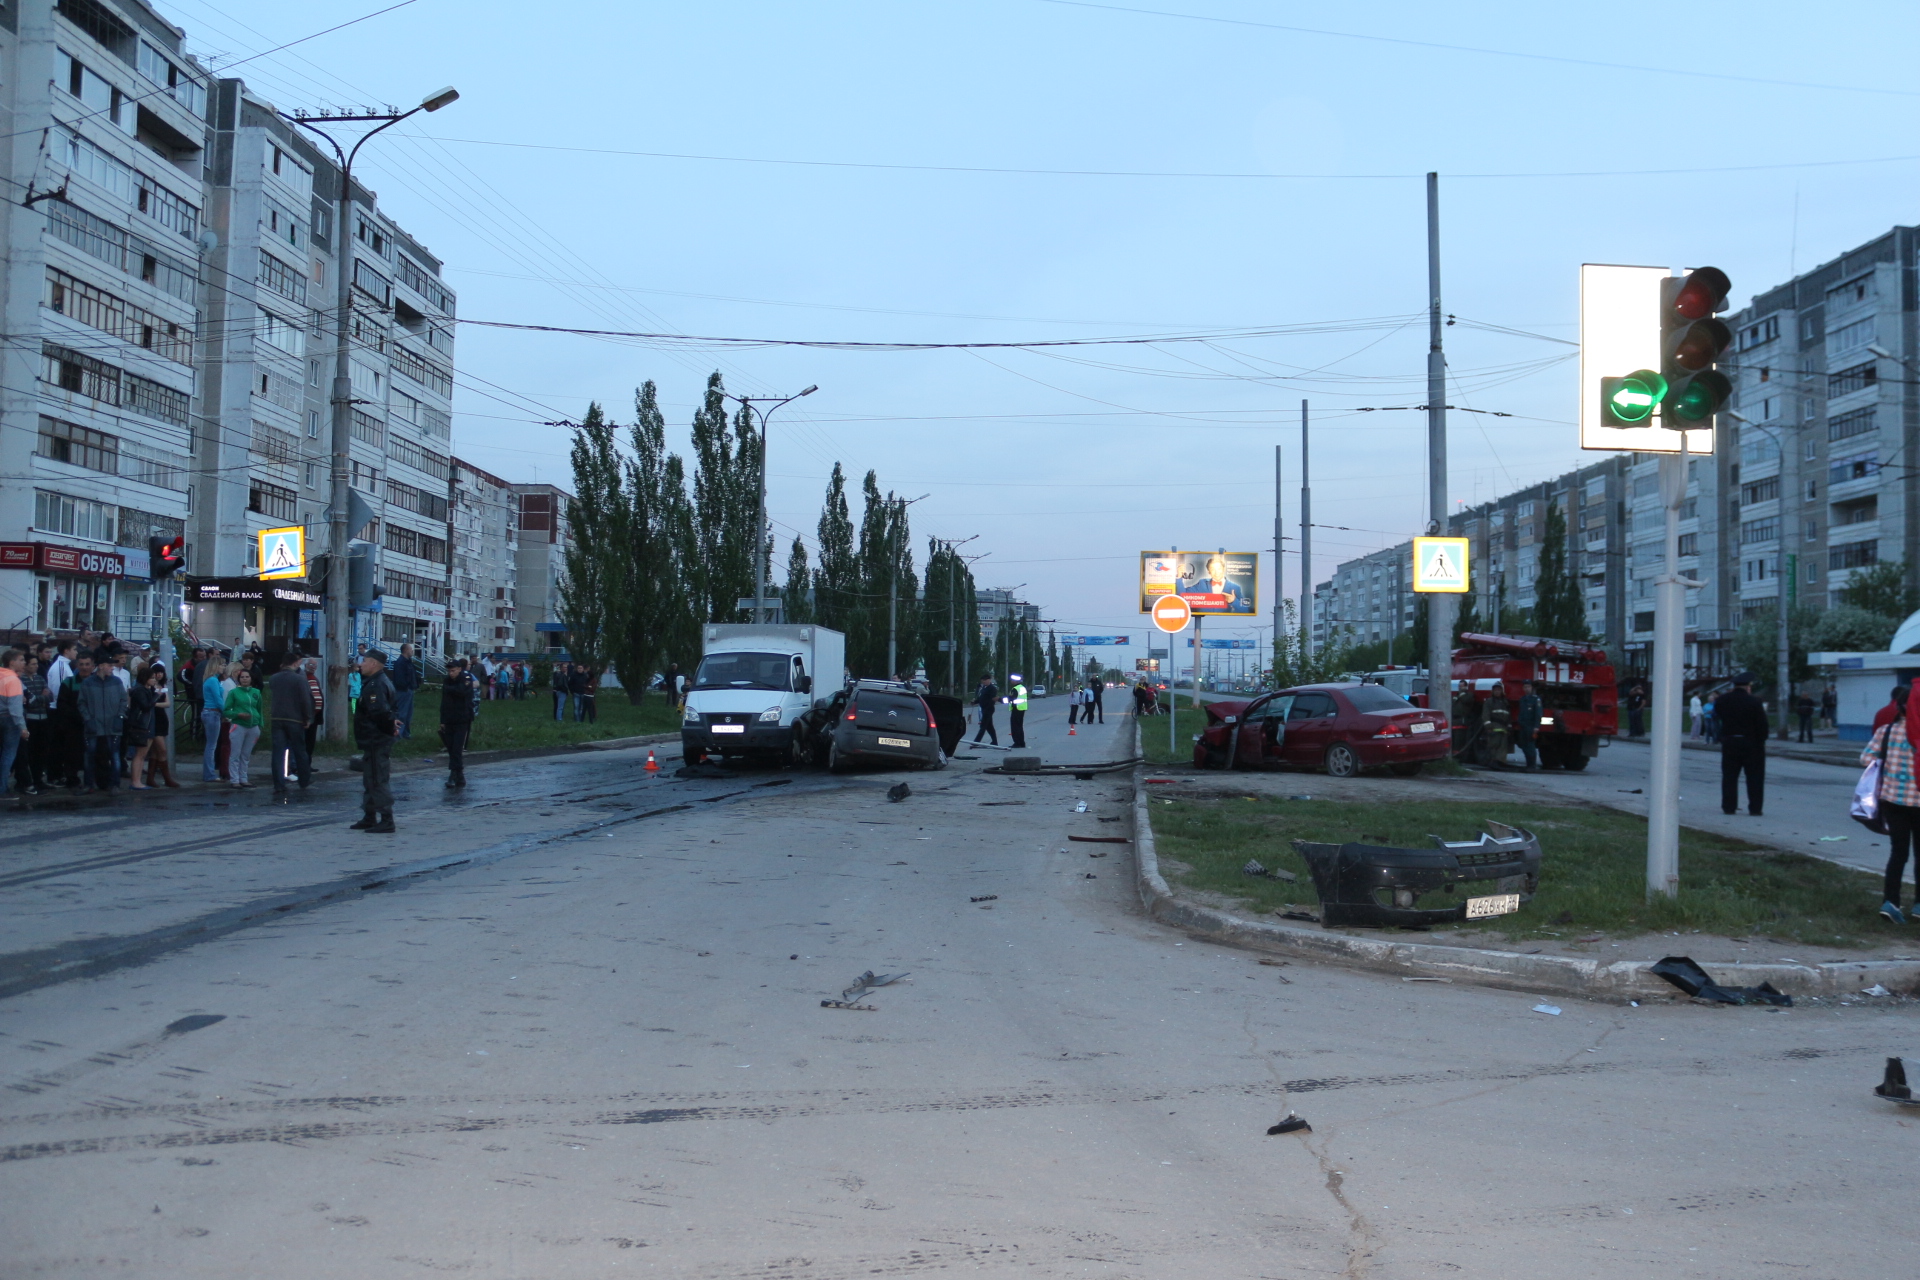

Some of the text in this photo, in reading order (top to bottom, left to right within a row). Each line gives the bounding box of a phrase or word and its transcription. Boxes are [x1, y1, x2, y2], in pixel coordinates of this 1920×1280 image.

[81, 553, 123, 575] ОБУВЬ
[274, 588, 321, 604] СВАДЕБНЫЙ ВАЛЬС
[1573, 671, 1583, 679] 29
[1470, 898, 1505, 915] А626ХК
